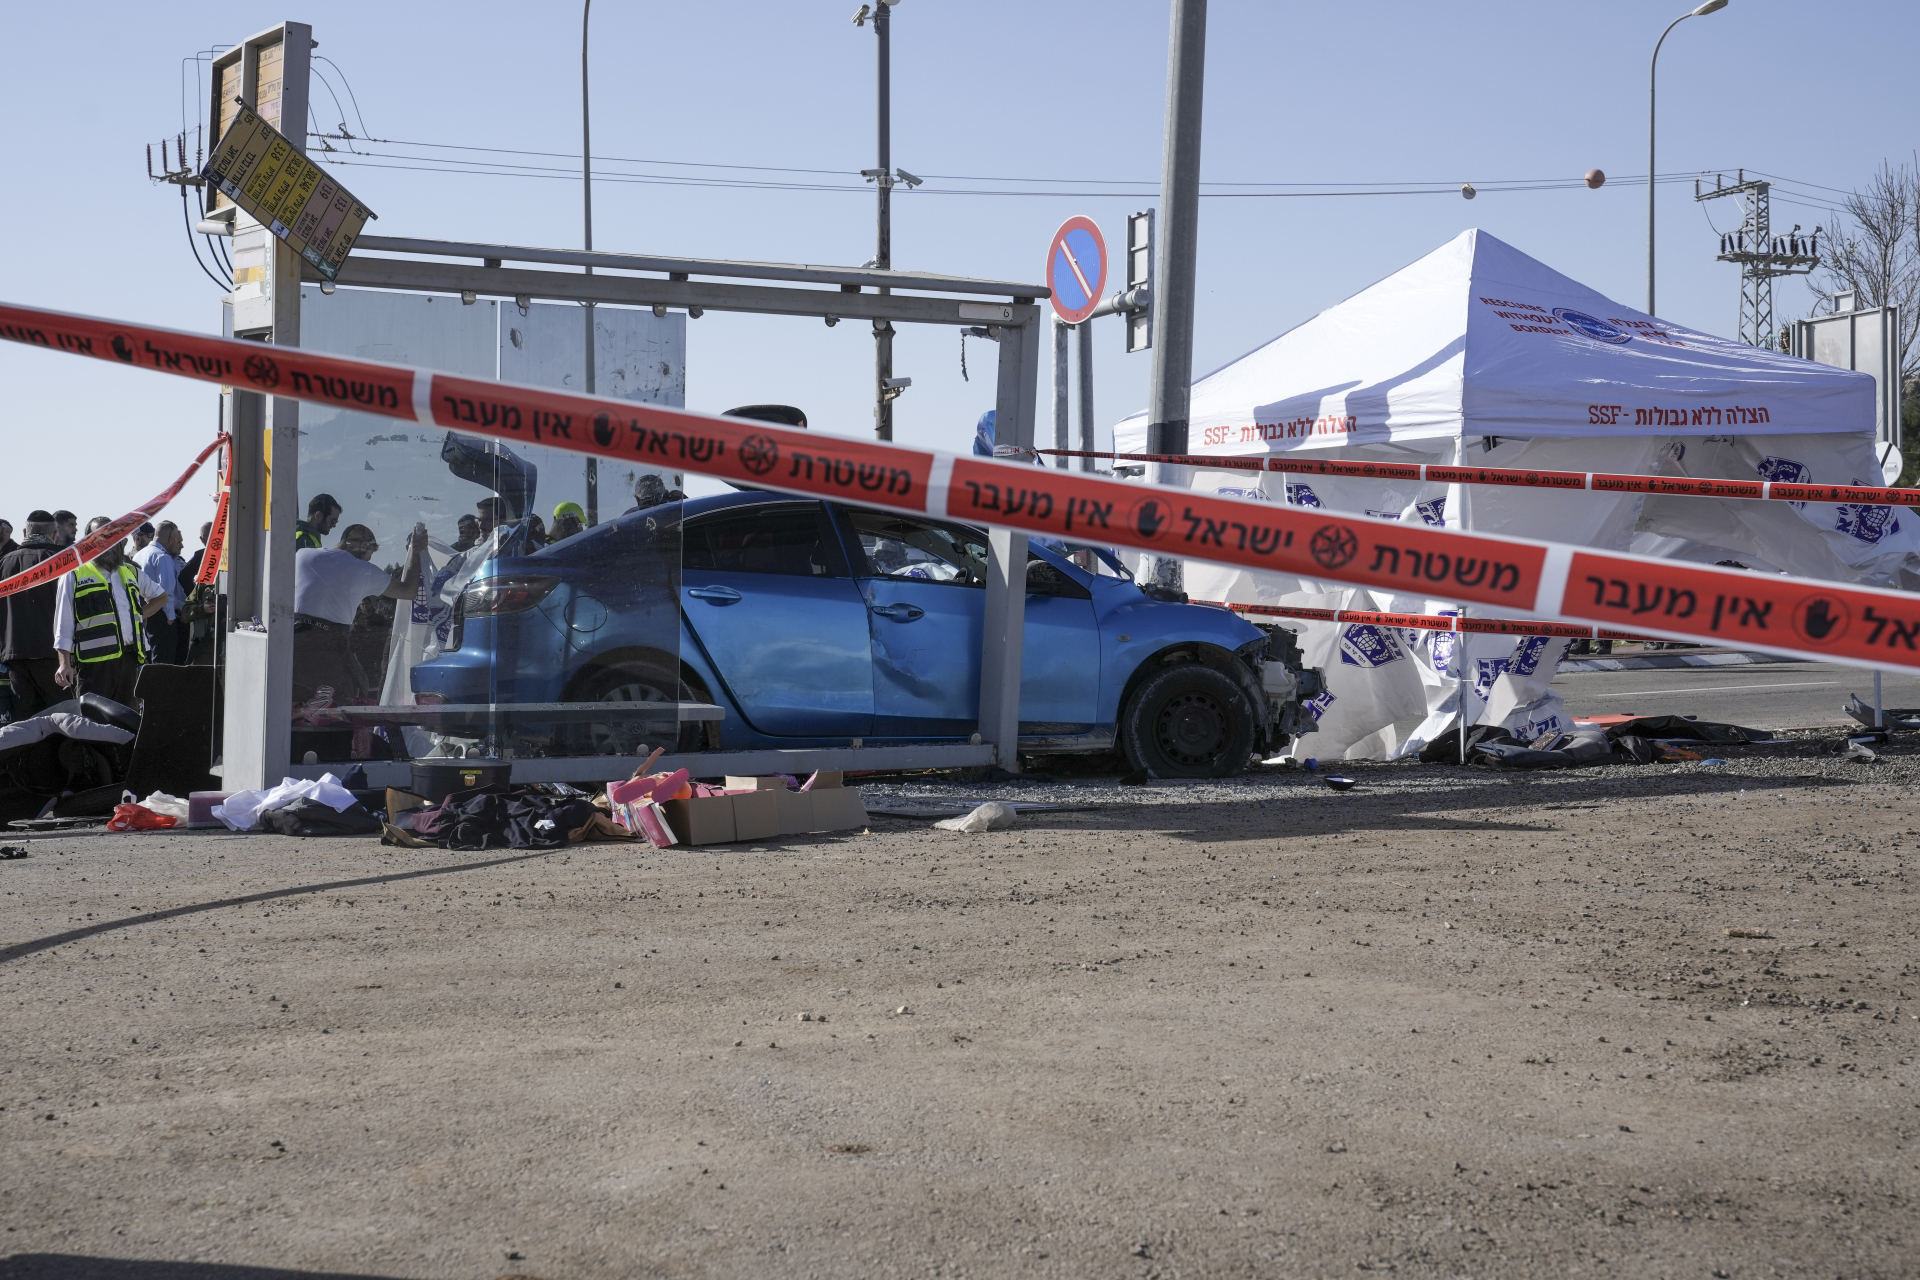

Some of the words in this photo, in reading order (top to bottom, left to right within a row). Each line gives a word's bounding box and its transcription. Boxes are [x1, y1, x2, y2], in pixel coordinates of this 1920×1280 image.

[216, 155, 231, 174] גבעת
[225, 144, 238, 159] זאב
[243, 112, 255, 125] 105
[230, 164, 246, 186] הורדה
[241, 149, 257, 169] בלבד
[258, 125, 271, 140] 237
[251, 179, 266, 200] מודיעין
[262, 165, 276, 183] עילית
[269, 141, 286, 162] 338
[282, 152, 303, 178] 318,328
[277, 179, 290, 197] עילית
[297, 165, 317, 193] 308,348
[266, 192, 282, 213] מודיעין
[292, 193, 306, 210] עילית
[300, 223, 312, 239] גבעת
[308, 214, 318, 225] זאב
[318, 182, 332, 200] 139
[281, 205, 297, 226] מודיעין
[315, 236, 327, 252] גבעת
[323, 226, 333, 239] זאב
[333, 195, 348, 213] 133
[334, 241, 347, 259] אביב
[352, 205, 363, 218] 471
[1479, 297, 1547, 313] RESCUERS
[1493, 310, 1560, 324] WITHOUT
[1608, 318, 1655, 330] הצלה
[1509, 323, 1574, 336] BORDERS
[57, 334, 96, 355] אין
[145, 341, 232, 378] ישראל
[290, 370, 398, 408] משטרת
[443, 395, 521, 431] מעבר
[1634, 406, 1688, 427] גבולות
[1691, 405, 1722, 426] ללא
[1726, 405, 1771, 424] הצלה
[533, 410, 573, 440] אין
[1240, 421, 1284, 443] גבולות
[1286, 417, 1314, 439] ללא
[1317, 414, 1357, 436] הצלה
[630, 418, 725, 463] ישראל
[1178, 456, 1206, 465] ישראל
[1224, 459, 1259, 468] משטרת
[1273, 462, 1297, 471] מעבר
[1300, 463, 1313, 472] אין
[1330, 464, 1360, 474] ישראל
[788, 452, 913, 496] משטרת
[1379, 467, 1416, 477] משטרת
[1430, 470, 1457, 480] מעבר
[1459, 472, 1473, 481] אין
[1491, 472, 1522, 483] ישראל
[1541, 475, 1581, 486] משטרת
[1596, 478, 1624, 489] מעבר
[1627, 479, 1642, 490] אין
[1661, 480, 1694, 492] ישראל
[1715, 484, 1758, 495] משטרת
[1774, 487, 1804, 497] מעבר
[964, 480, 1053, 519] מעבר
[1808, 487, 1823, 499] אין
[1845, 488, 1881, 501] ישראל
[1065, 497, 1113, 531] אין
[1182, 507, 1294, 555] ישראל
[30, 568, 46, 583] ישראל
[63, 553, 76, 566] מעבר
[200, 554, 216, 583] ישראל
[1369, 543, 1521, 592] משטרת
[1585, 576, 1698, 619] מעבר
[1271, 606, 1293, 615] ישראל
[1304, 609, 1331, 618] משטרת
[1341, 613, 1360, 621] מעבר
[1710, 594, 1773, 631] אין
[1385, 616, 1407, 624] ישראל
[1420, 620, 1449, 628] משטרת
[1459, 621, 1481, 630] מעבר
[1484, 623, 1496, 631] אין
[1511, 623, 1538, 632] ישראל
[1555, 626, 1589, 635] משטרת
